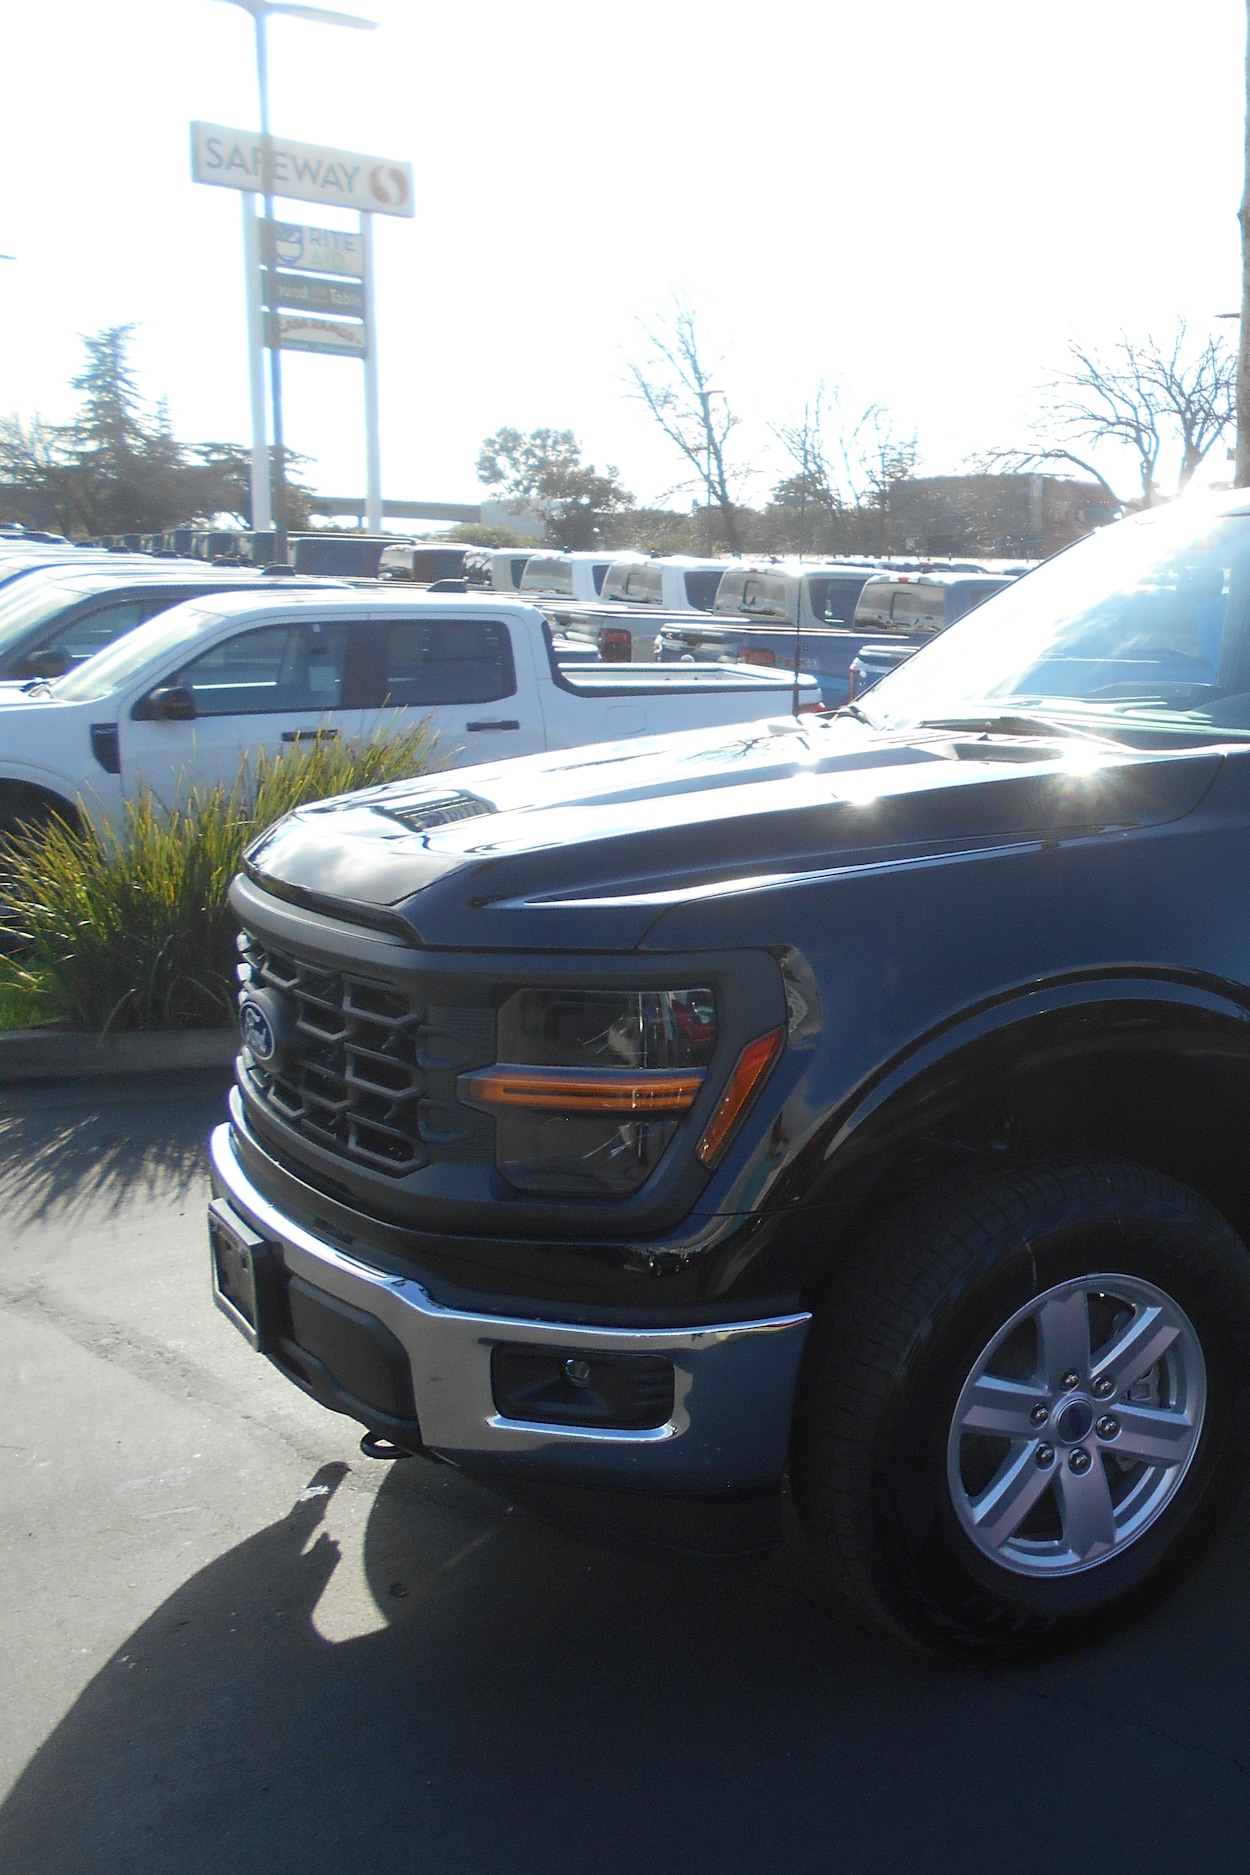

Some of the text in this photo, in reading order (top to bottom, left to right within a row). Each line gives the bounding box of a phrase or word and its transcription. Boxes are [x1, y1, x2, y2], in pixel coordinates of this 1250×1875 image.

[205, 137, 361, 194] SAFEWAY
[309, 228, 356, 252] RITE
[310, 248, 346, 271] AID
